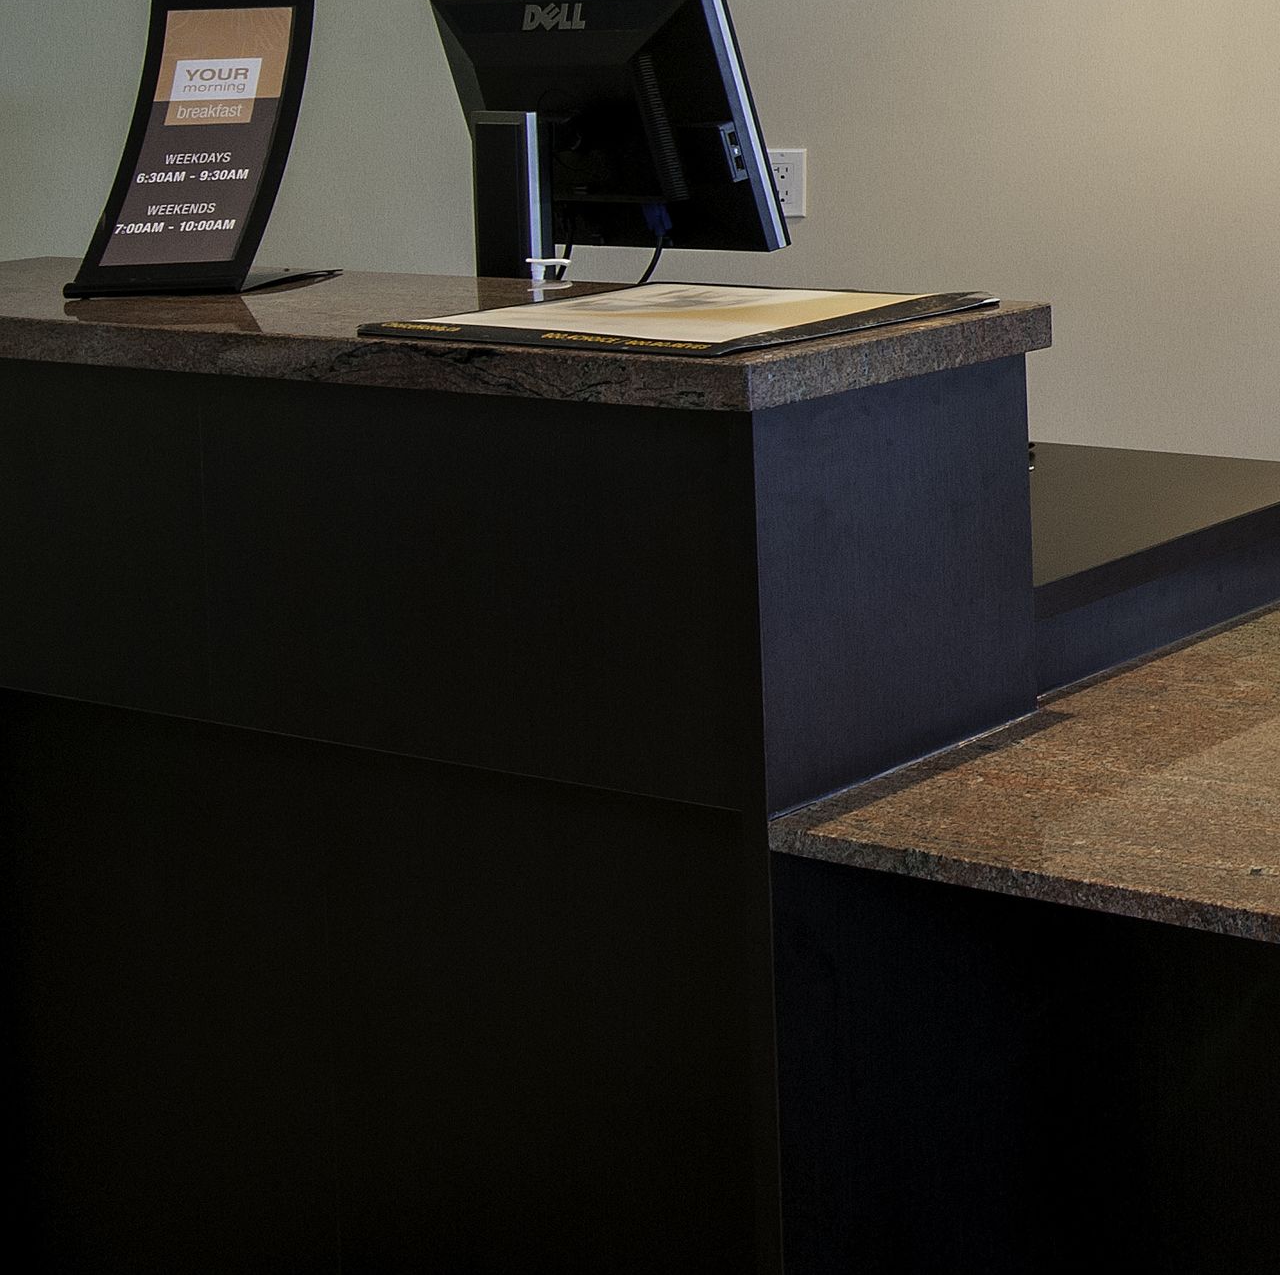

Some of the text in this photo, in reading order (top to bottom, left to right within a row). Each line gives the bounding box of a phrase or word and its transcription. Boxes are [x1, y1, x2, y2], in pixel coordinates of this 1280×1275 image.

[521, 2, 586, 31] DELL
[186, 68, 249, 82] YOUR
[183, 82, 246, 94] morning
[176, 104, 243, 119] breakfast
[165, 152, 231, 165] WEEKDAYS
[136, 171, 186, 184] 6:30AM
[199, 169, 249, 182] 9:30AM
[147, 202, 216, 216] WEEKENDS
[114, 222, 165, 234] 7:00AM
[179, 220, 236, 232] 10:00AM
